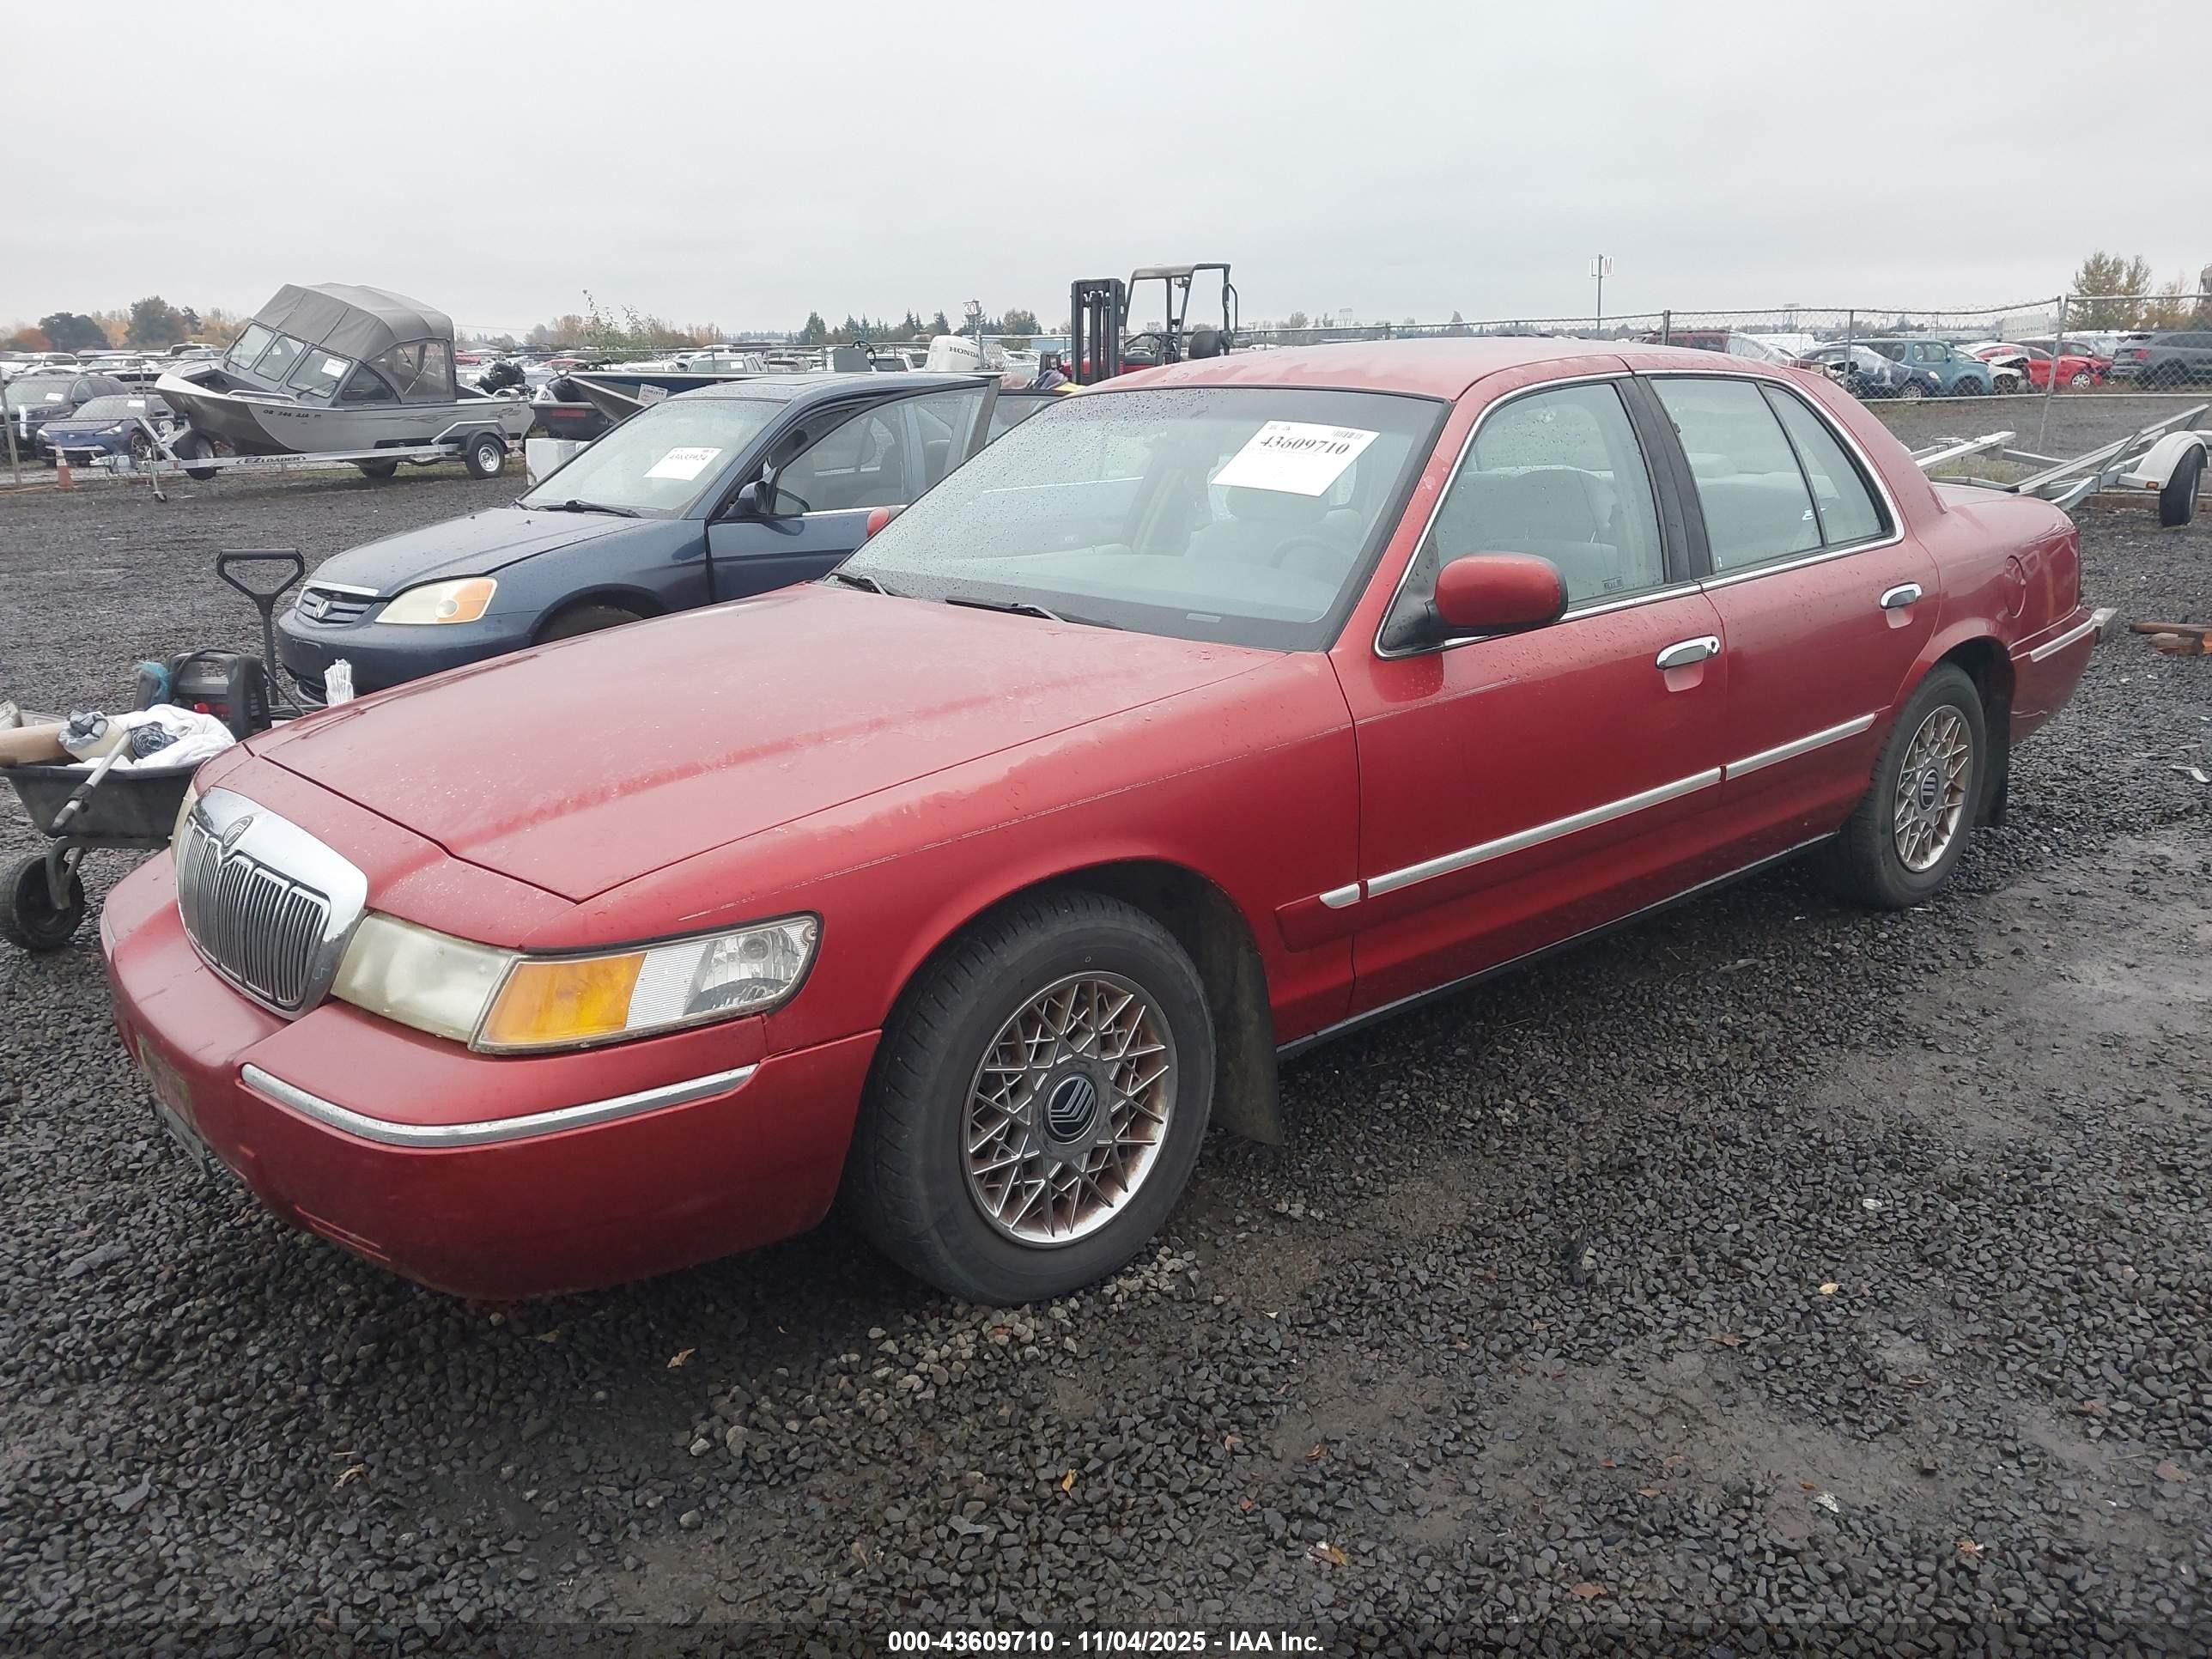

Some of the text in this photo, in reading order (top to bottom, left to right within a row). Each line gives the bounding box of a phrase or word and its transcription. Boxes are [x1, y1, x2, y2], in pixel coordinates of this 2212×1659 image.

[1604, 257, 1613, 276] M
[964, 303, 975, 314] 30
[949, 346, 980, 358] HONDA
[1260, 435, 1350, 454] 43609710
